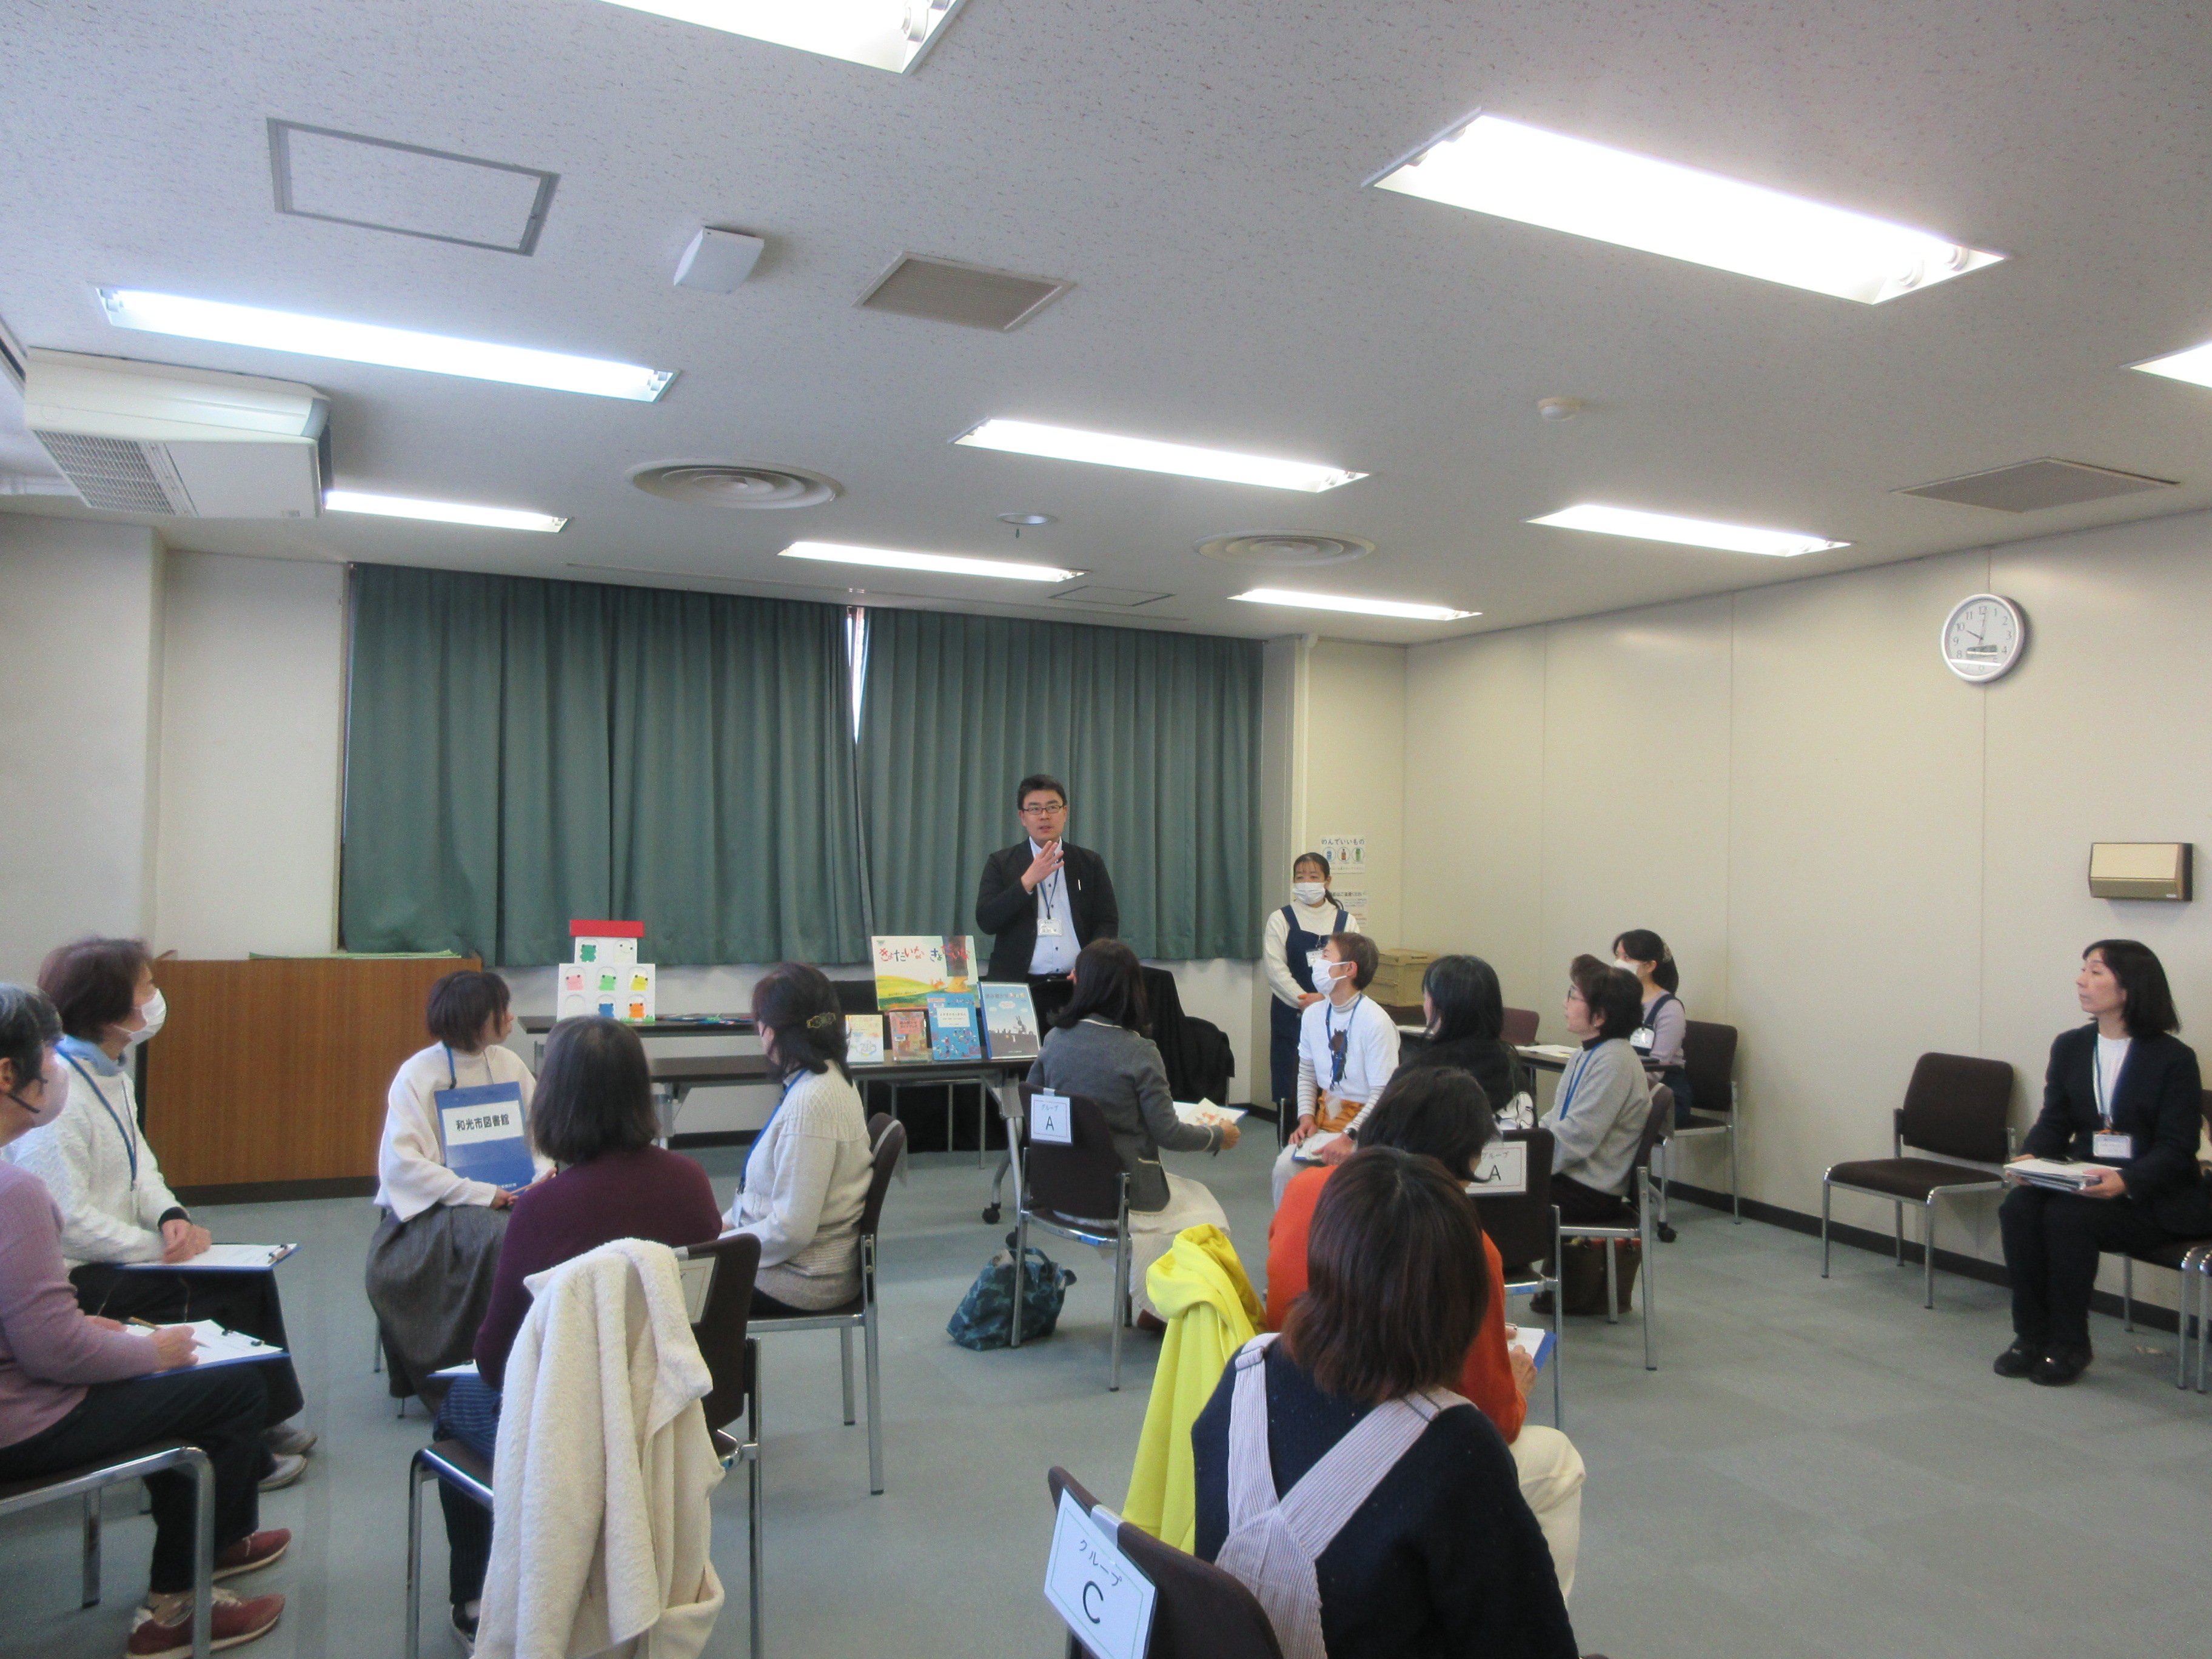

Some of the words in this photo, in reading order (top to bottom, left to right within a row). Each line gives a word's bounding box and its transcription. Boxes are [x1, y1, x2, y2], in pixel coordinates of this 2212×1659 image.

[1966, 611, 1972, 620] 11
[2003, 615, 2008, 625] 2
[1956, 623, 1965, 631] 10
[2006, 631, 2012, 640] 3
[1953, 637, 1959, 646] 9
[1956, 650, 1962, 659] 8
[456, 1113, 510, 1131] 和光市図書館
[1046, 1116, 1054, 1131] A
[1490, 1164, 1501, 1181] A
[1082, 1580, 1104, 1624] C
